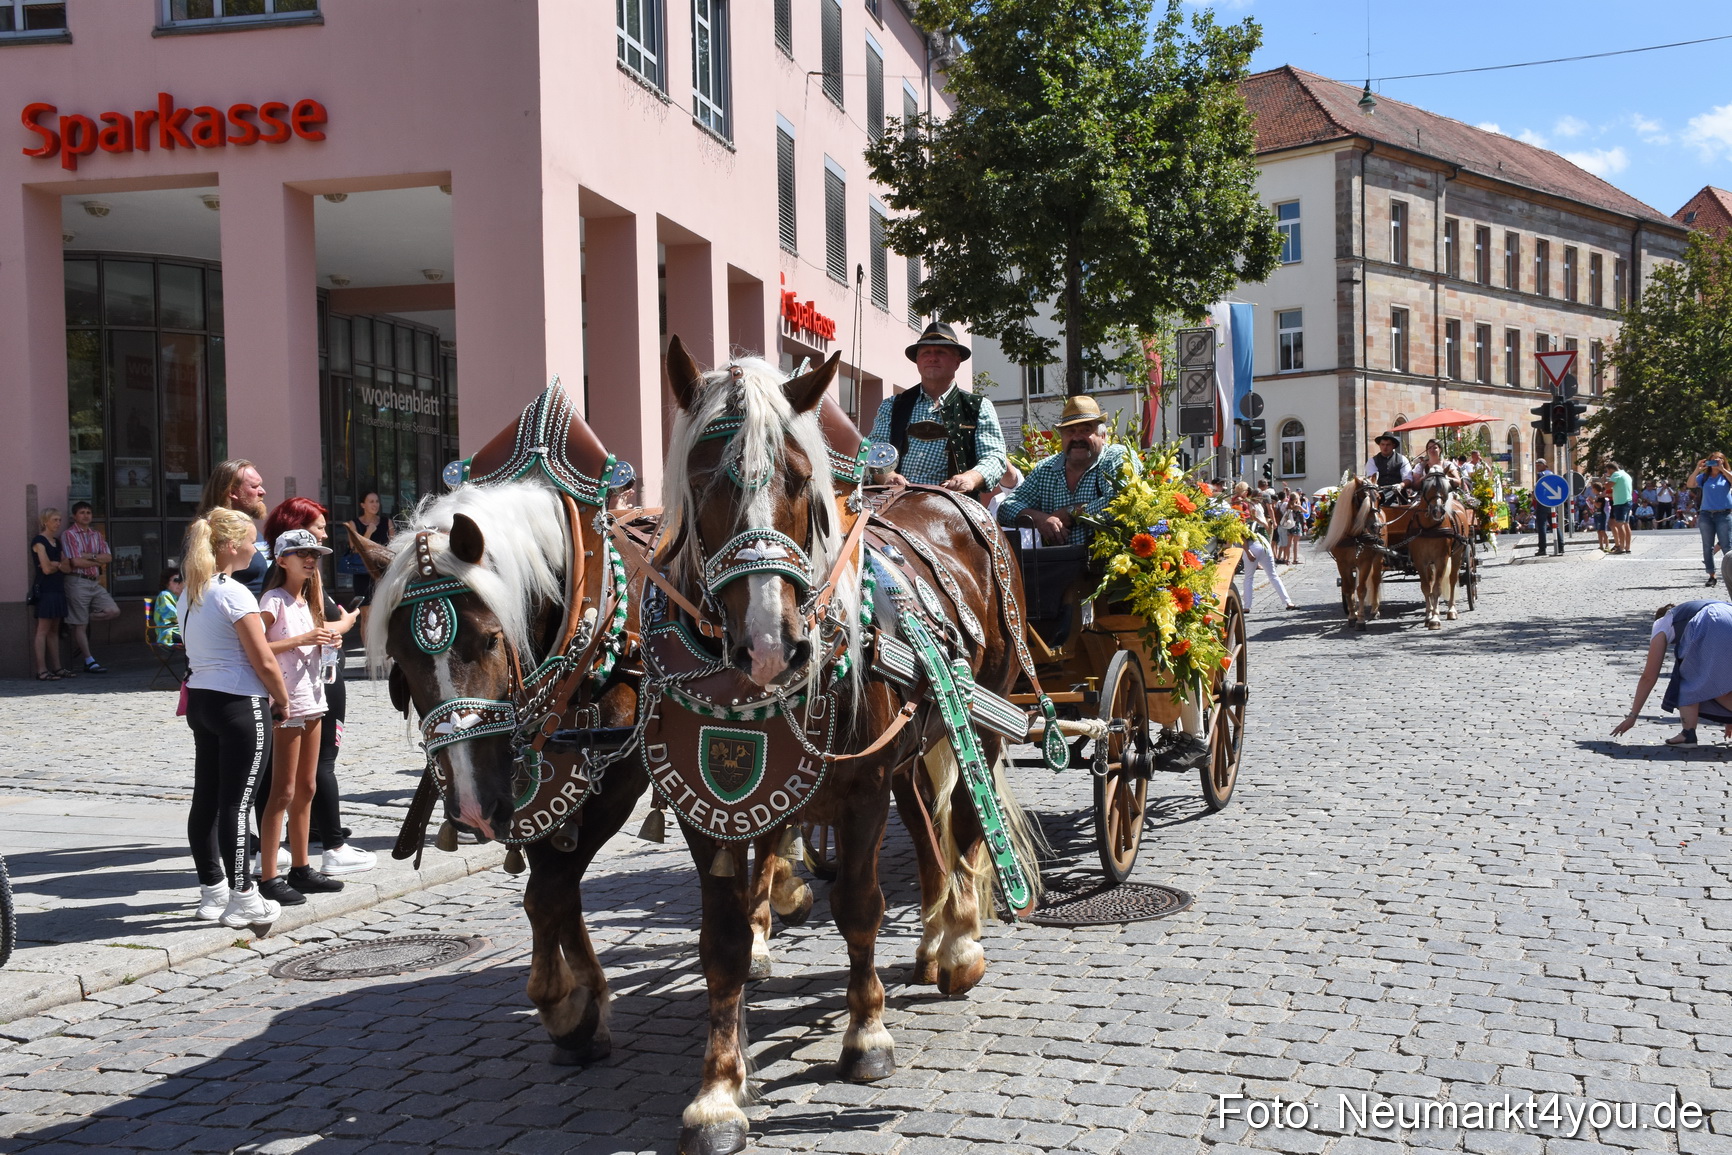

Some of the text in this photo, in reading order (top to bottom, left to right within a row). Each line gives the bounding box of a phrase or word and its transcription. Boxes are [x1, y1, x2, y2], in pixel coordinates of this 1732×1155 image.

[21, 92, 328, 171] Sparkasse
[785, 291, 836, 341] Sparkasse
[1190, 340, 1203, 351] 30
[361, 384, 440, 416] wochenblatt
[299, 531, 316, 546] LA
[253, 709, 263, 720] NO
[255, 722, 265, 750] NEEDED
[249, 751, 263, 776] WORDS
[914, 625, 1022, 891] DITTRICH
[247, 776, 256, 786] NO
[647, 743, 819, 833] DIETERSDORF
[237, 812, 247, 836] WORDS
[236, 836, 246, 847] NO
[235, 848, 245, 874] NEEDED
